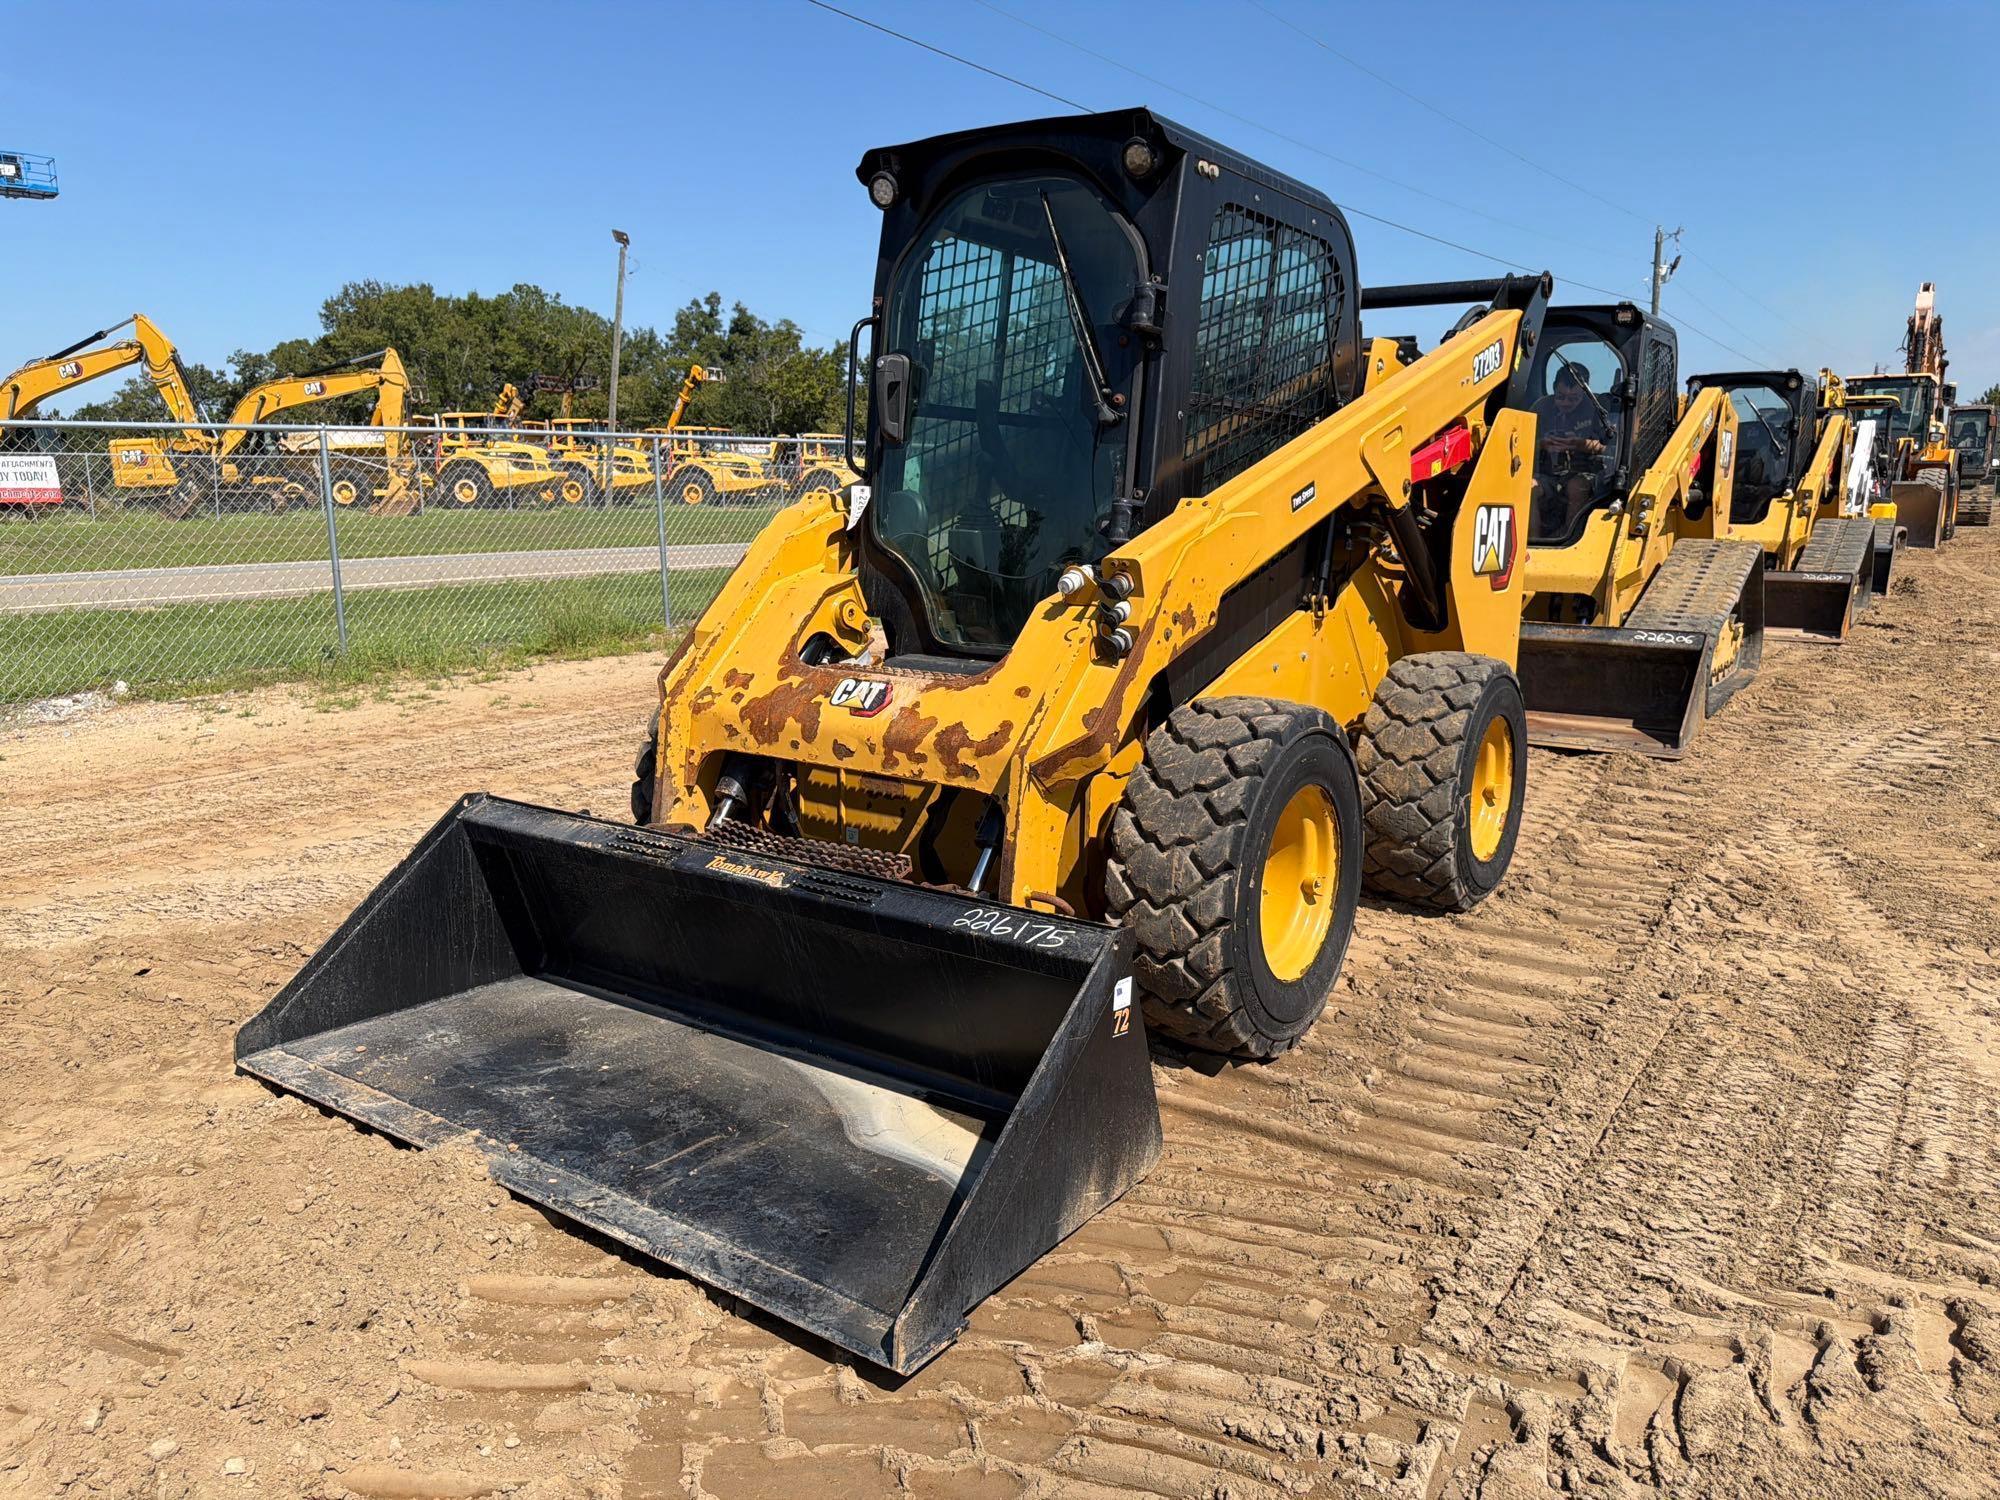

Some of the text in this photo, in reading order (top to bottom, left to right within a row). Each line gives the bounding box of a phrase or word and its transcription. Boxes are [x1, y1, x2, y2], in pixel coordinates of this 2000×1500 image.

[58, 362, 78, 378] CAT
[1473, 341, 1501, 383] 272D3
[303, 381, 322, 395] CAT
[121, 450, 142, 463] CAT
[14, 471, 48, 482] TODAY!
[1473, 506, 1511, 573] CAT
[1633, 630, 1696, 645] 226206
[830, 678, 888, 709] CAT
[705, 855, 785, 882] Tomahawk
[952, 908, 1076, 948] 226175
[1113, 1007, 1130, 1034] 72
